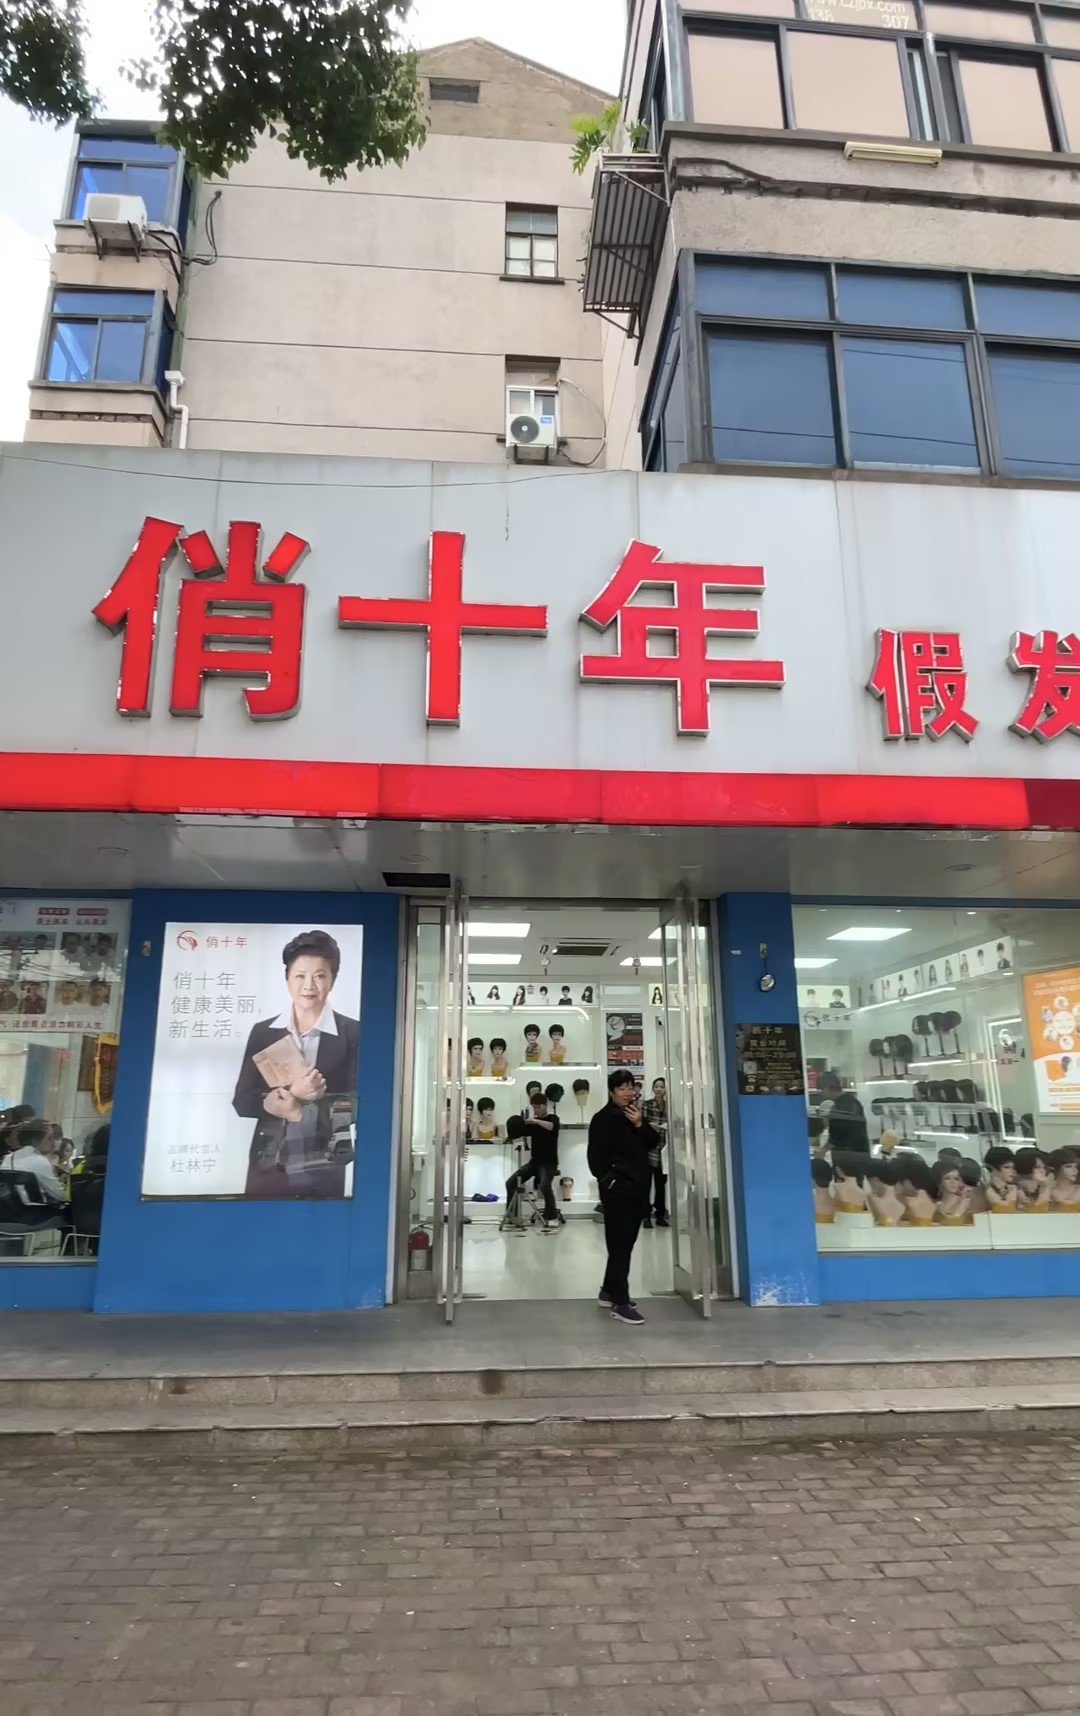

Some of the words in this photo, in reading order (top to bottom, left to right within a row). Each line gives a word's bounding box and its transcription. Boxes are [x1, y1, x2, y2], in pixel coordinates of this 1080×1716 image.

[881, 14, 910, 30] 307
[91, 516, 786, 737] 俏十年
[865, 626, 1080, 745] 假发
[206, 936, 248, 949] 俏十年
[173, 971, 237, 991] 俏十年
